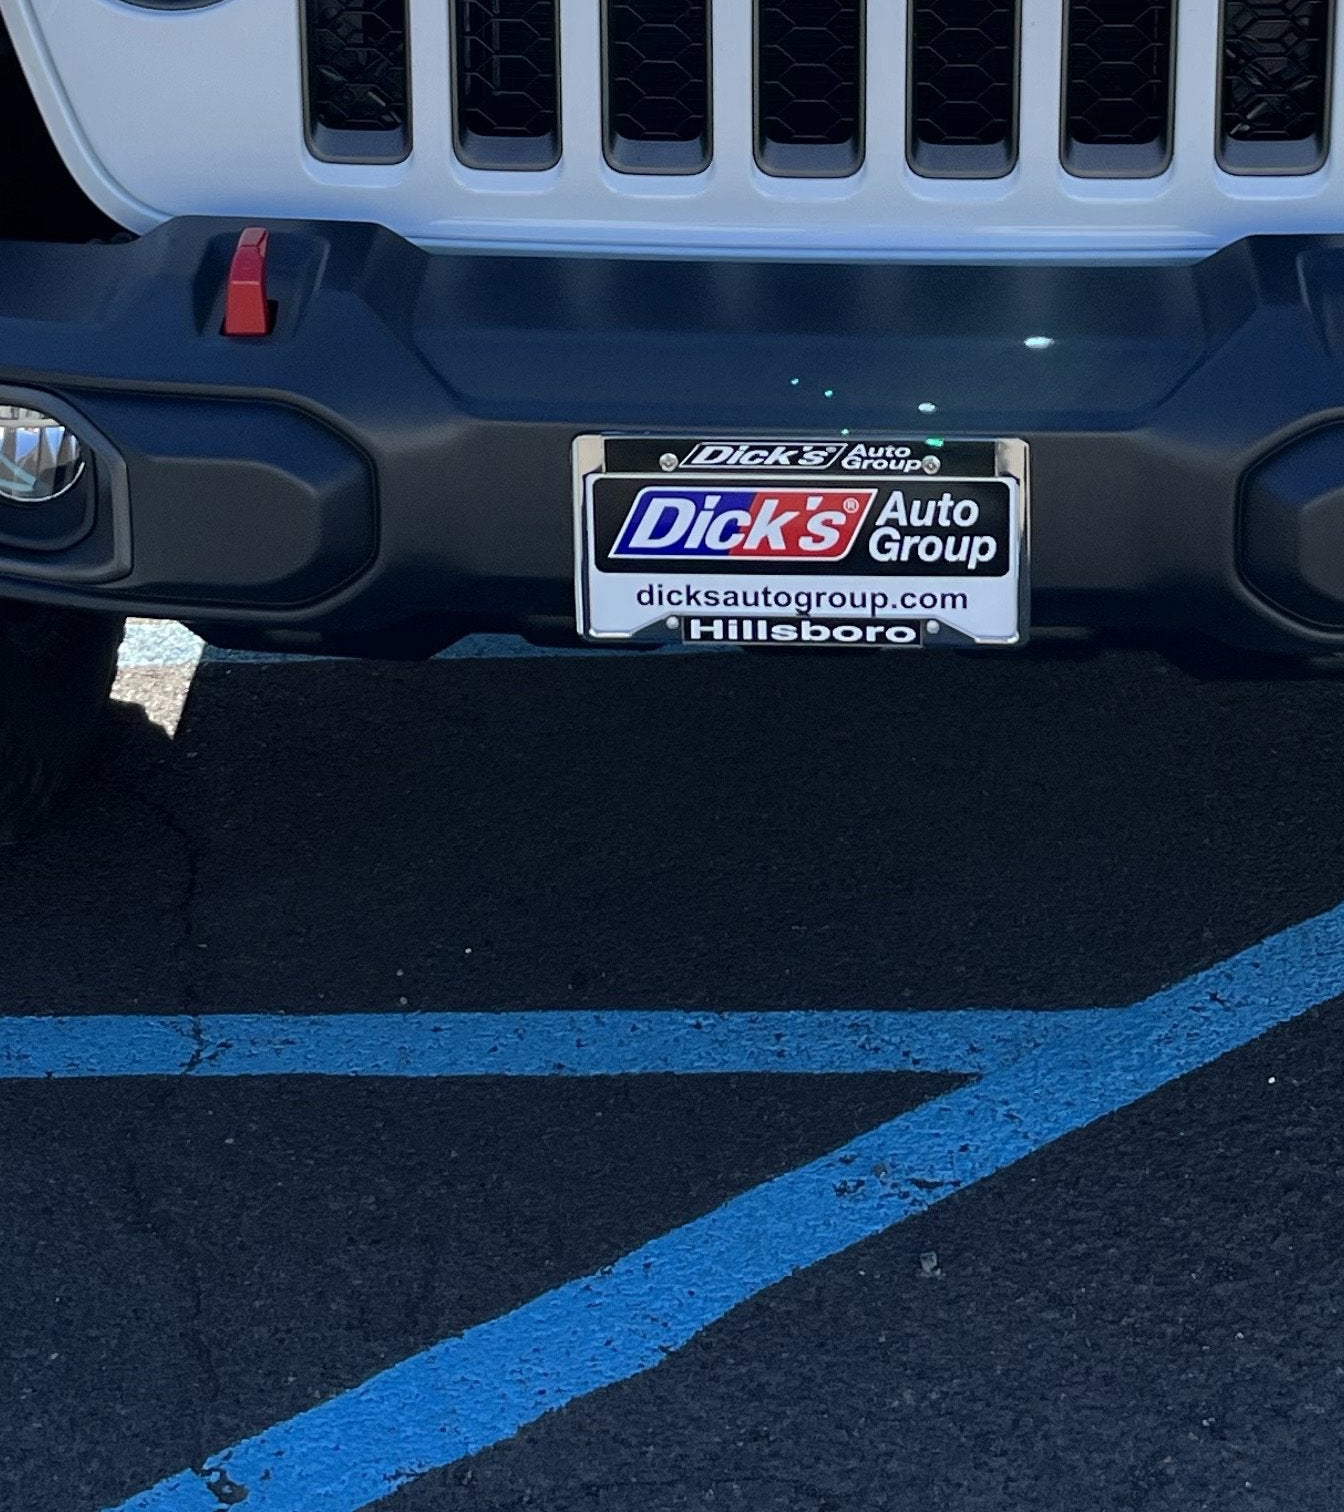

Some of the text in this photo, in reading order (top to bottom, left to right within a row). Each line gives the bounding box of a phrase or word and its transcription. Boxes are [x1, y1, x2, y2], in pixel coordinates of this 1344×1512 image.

[693, 445, 829, 466] Dick's
[840, 456, 923, 473] Group
[846, 443, 911, 458] Auto
[874, 490, 979, 528] Auto
[628, 494, 846, 553] Dick's
[868, 526, 998, 570] Group
[636, 584, 968, 615] dicksautogroup.com
[689, 618, 917, 644] Hillsboro
